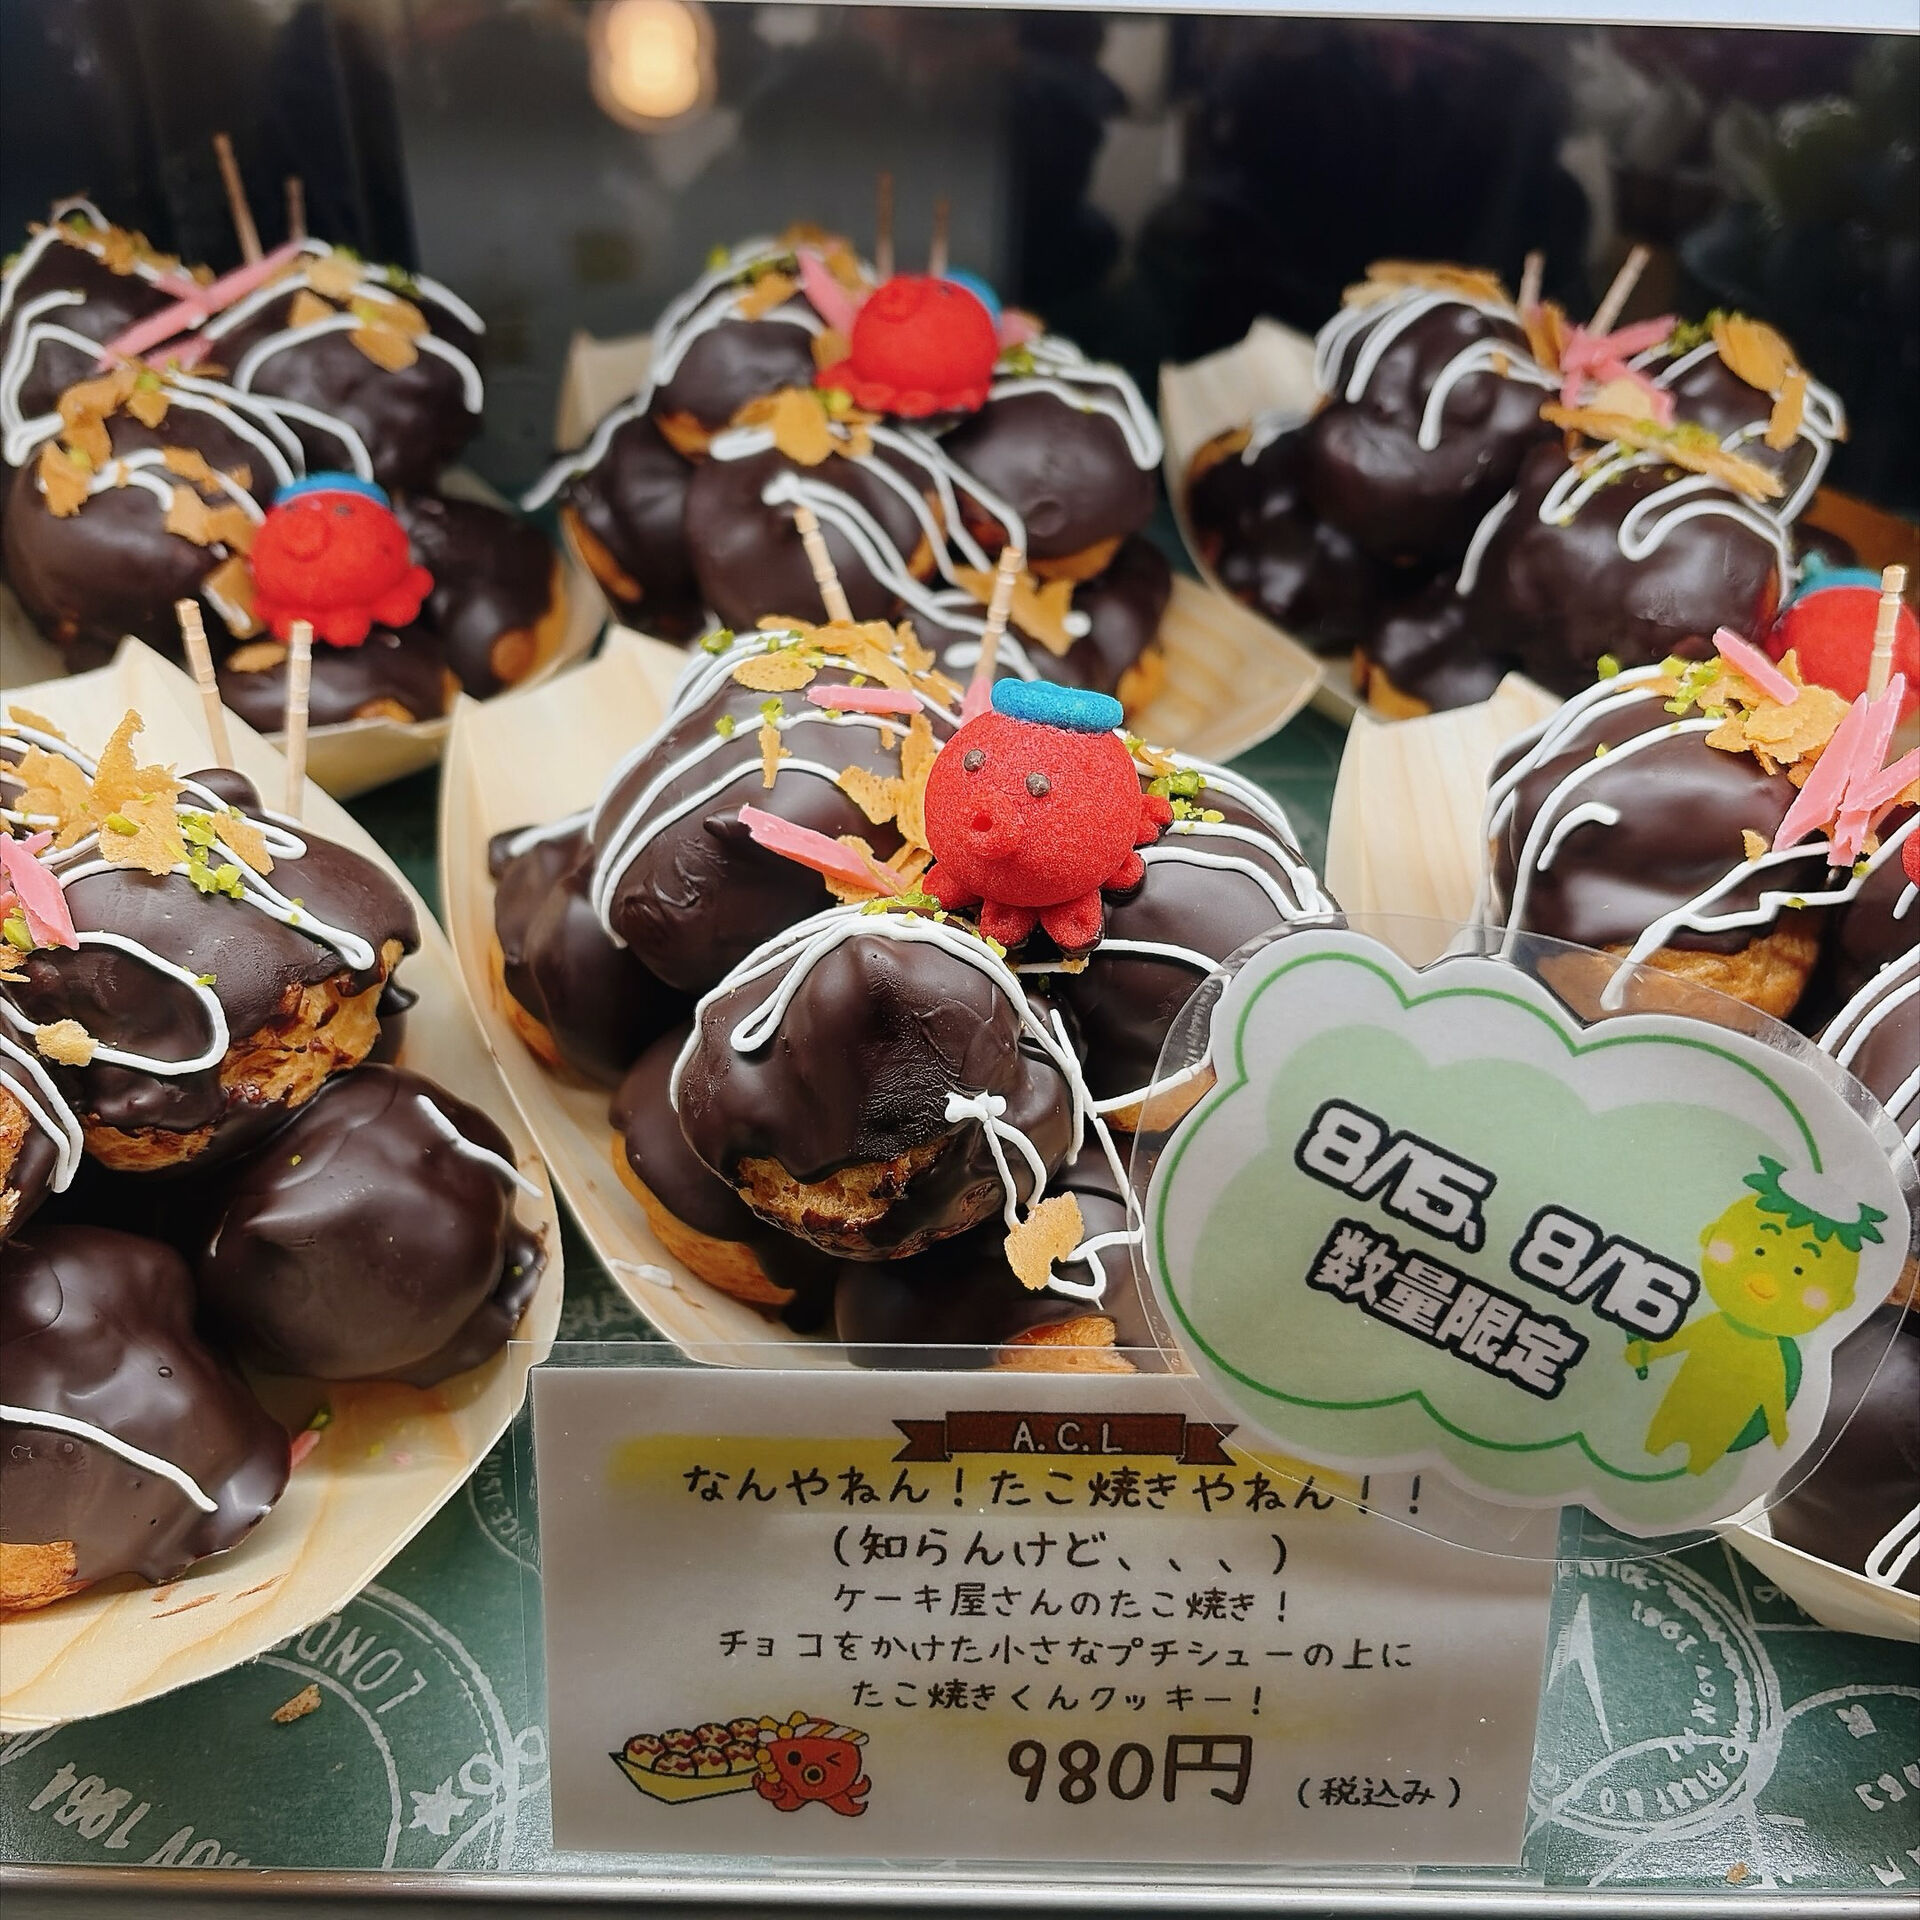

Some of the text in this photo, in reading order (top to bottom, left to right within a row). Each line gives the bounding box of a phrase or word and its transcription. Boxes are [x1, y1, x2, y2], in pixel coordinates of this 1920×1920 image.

[1306, 1217, 1588, 1399] 数量限定
[1013, 1420, 1123, 1453] A.C.L
[833, 1581, 1287, 1623] ケーキ屋さんのたこ焼き！
[275, 1610, 429, 1716] LOND
[718, 1629, 1412, 1670] チョコをかけた小さなプチシューの上に
[851, 1677, 1262, 1716] たこ焼きくんクッキー！
[1007, 1734, 1461, 1809] 980円 (税込み)
